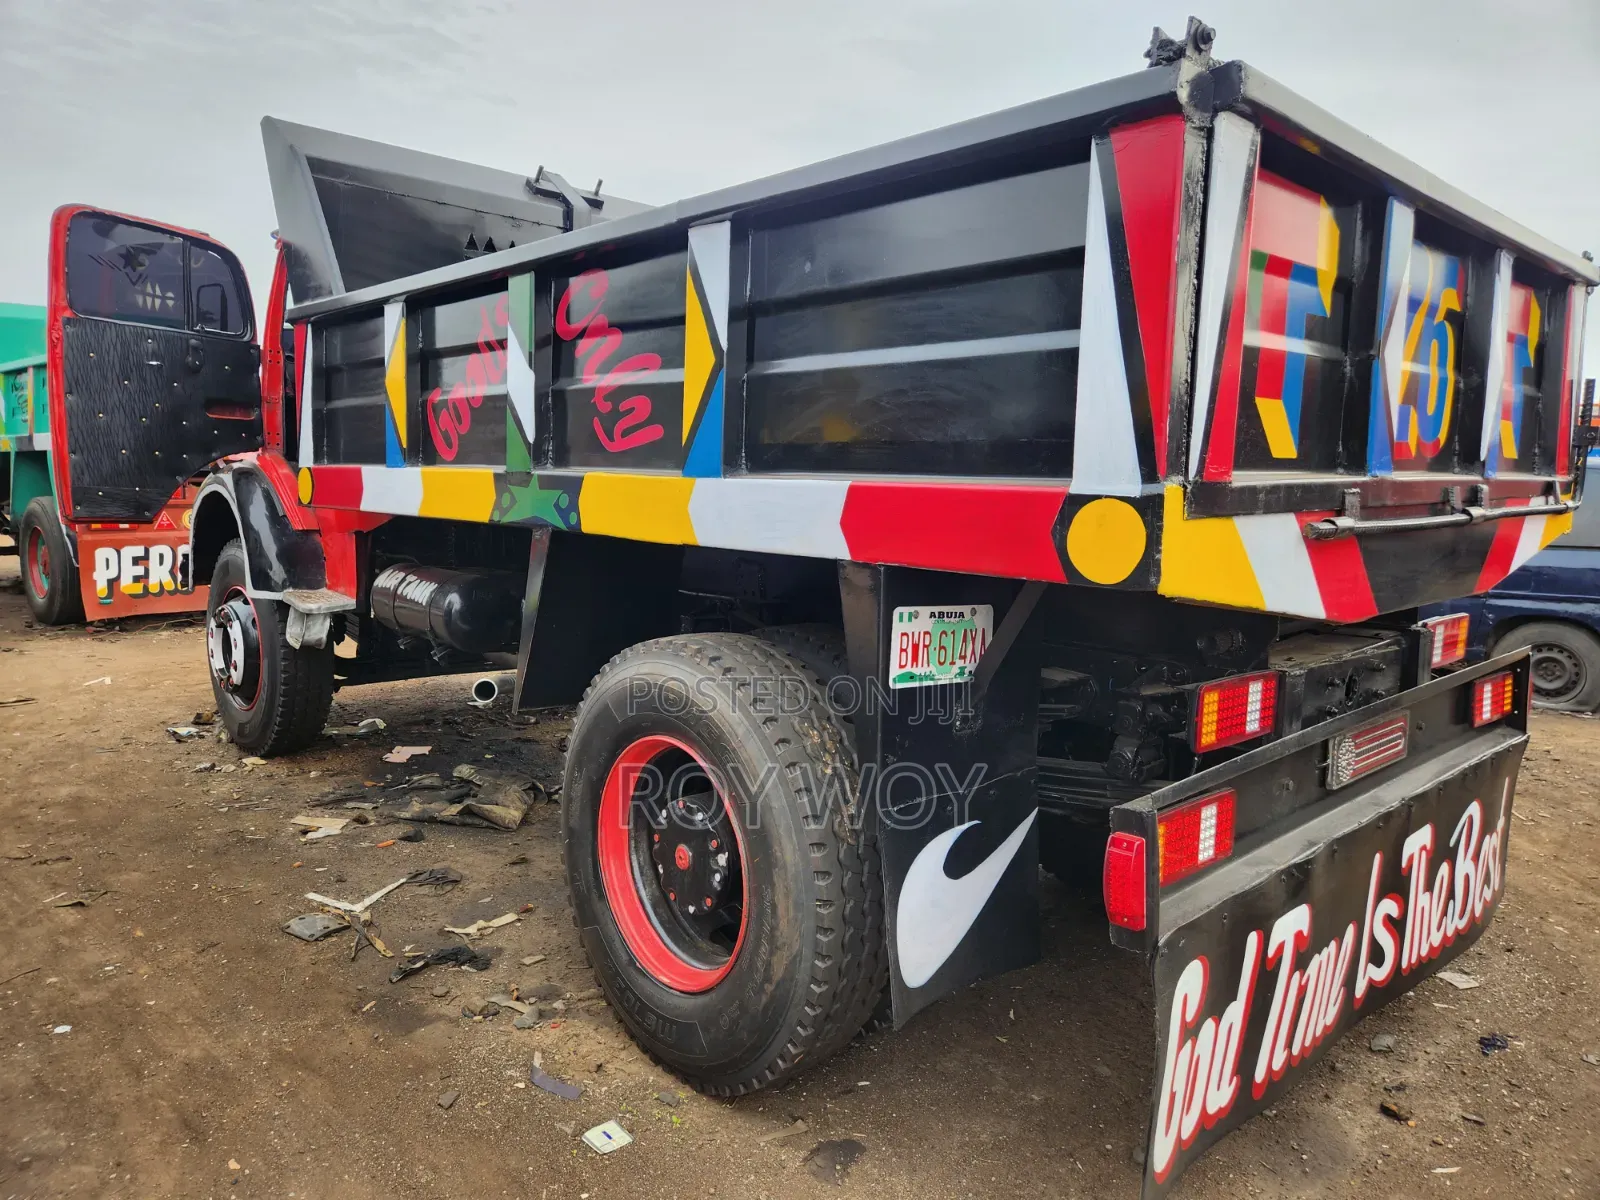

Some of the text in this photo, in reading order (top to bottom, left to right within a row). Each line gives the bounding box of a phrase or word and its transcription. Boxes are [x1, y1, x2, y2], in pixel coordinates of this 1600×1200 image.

[373, 569, 438, 606] AIR TANK
[929, 611, 965, 619] ABUJA
[1153, 929, 1264, 1184] God
[1354, 851, 1404, 1008] Is
[1400, 822, 1453, 976] The
[1446, 776, 1511, 936] Best
